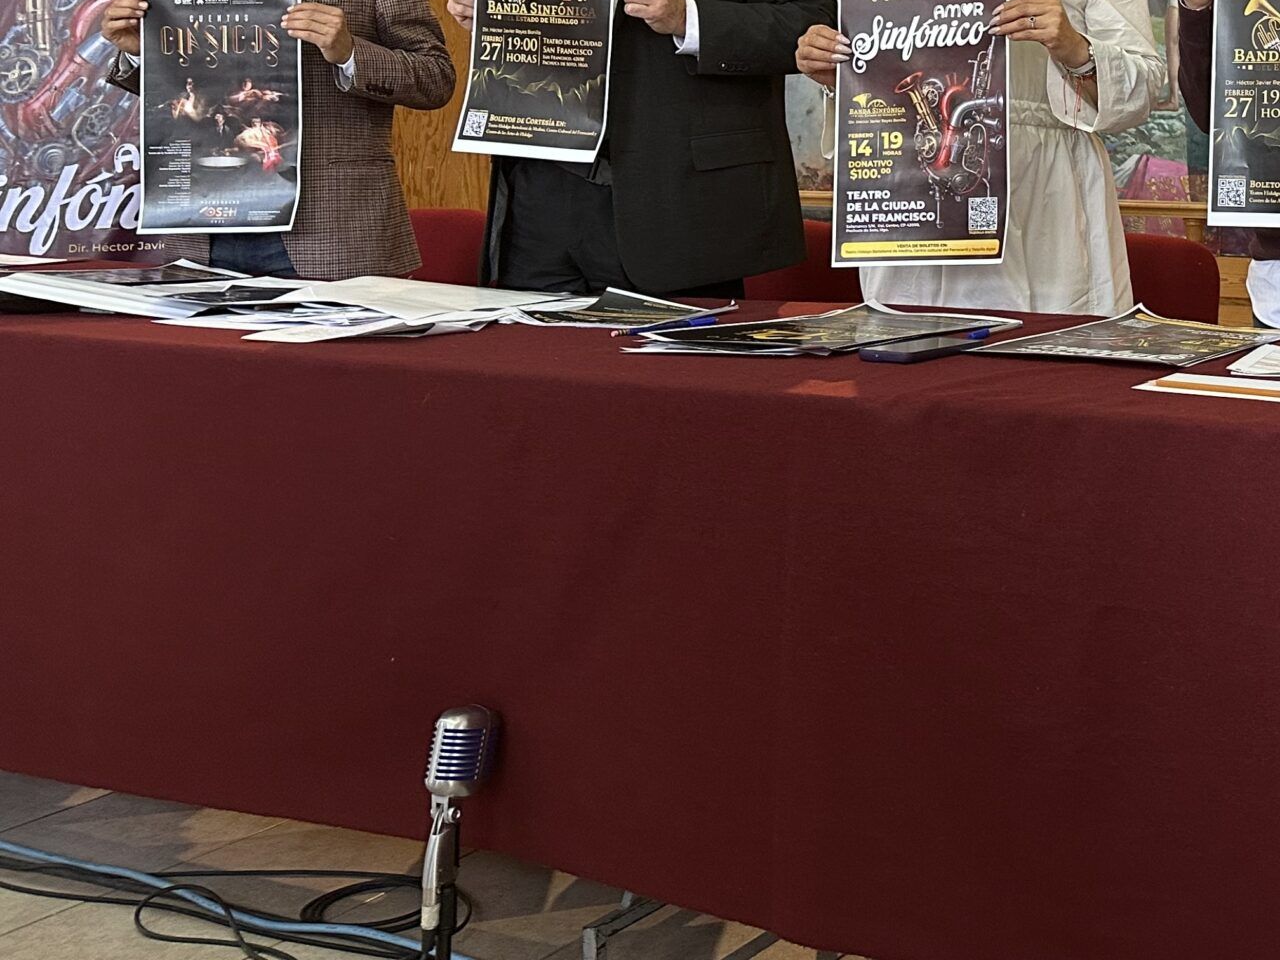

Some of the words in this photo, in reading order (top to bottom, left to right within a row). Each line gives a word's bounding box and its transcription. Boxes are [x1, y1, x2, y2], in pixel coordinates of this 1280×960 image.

[487, 0, 527, 14] BANDA
[530, 1, 597, 17] SINFÓNICA
[189, 14, 249, 23] CUENTOS
[550, 17, 579, 25] HIDALGO
[507, 37, 538, 52] 19:00
[579, 39, 603, 47] CIUDAD
[851, 15, 993, 74] Sinfónico
[480, 42, 501, 60] 27
[556, 47, 593, 55] FRANCISCO
[506, 53, 537, 63] HORAS
[1224, 97, 1252, 118] 27
[490, 114, 515, 123] BOLETOS
[881, 131, 903, 150] 19
[849, 139, 873, 157] 14
[848, 160, 893, 168] DONATIVO
[849, 167, 892, 180] $100.00
[847, 190, 890, 200] TEATRO
[847, 202, 863, 212] DE
[865, 202, 879, 211] LA
[883, 201, 925, 211] CIUDAD
[846, 213, 869, 224] SAN
[872, 212, 936, 223] FRANCISCO
[69, 243, 88, 253] Dir.
[137, 241, 165, 251] Javi
